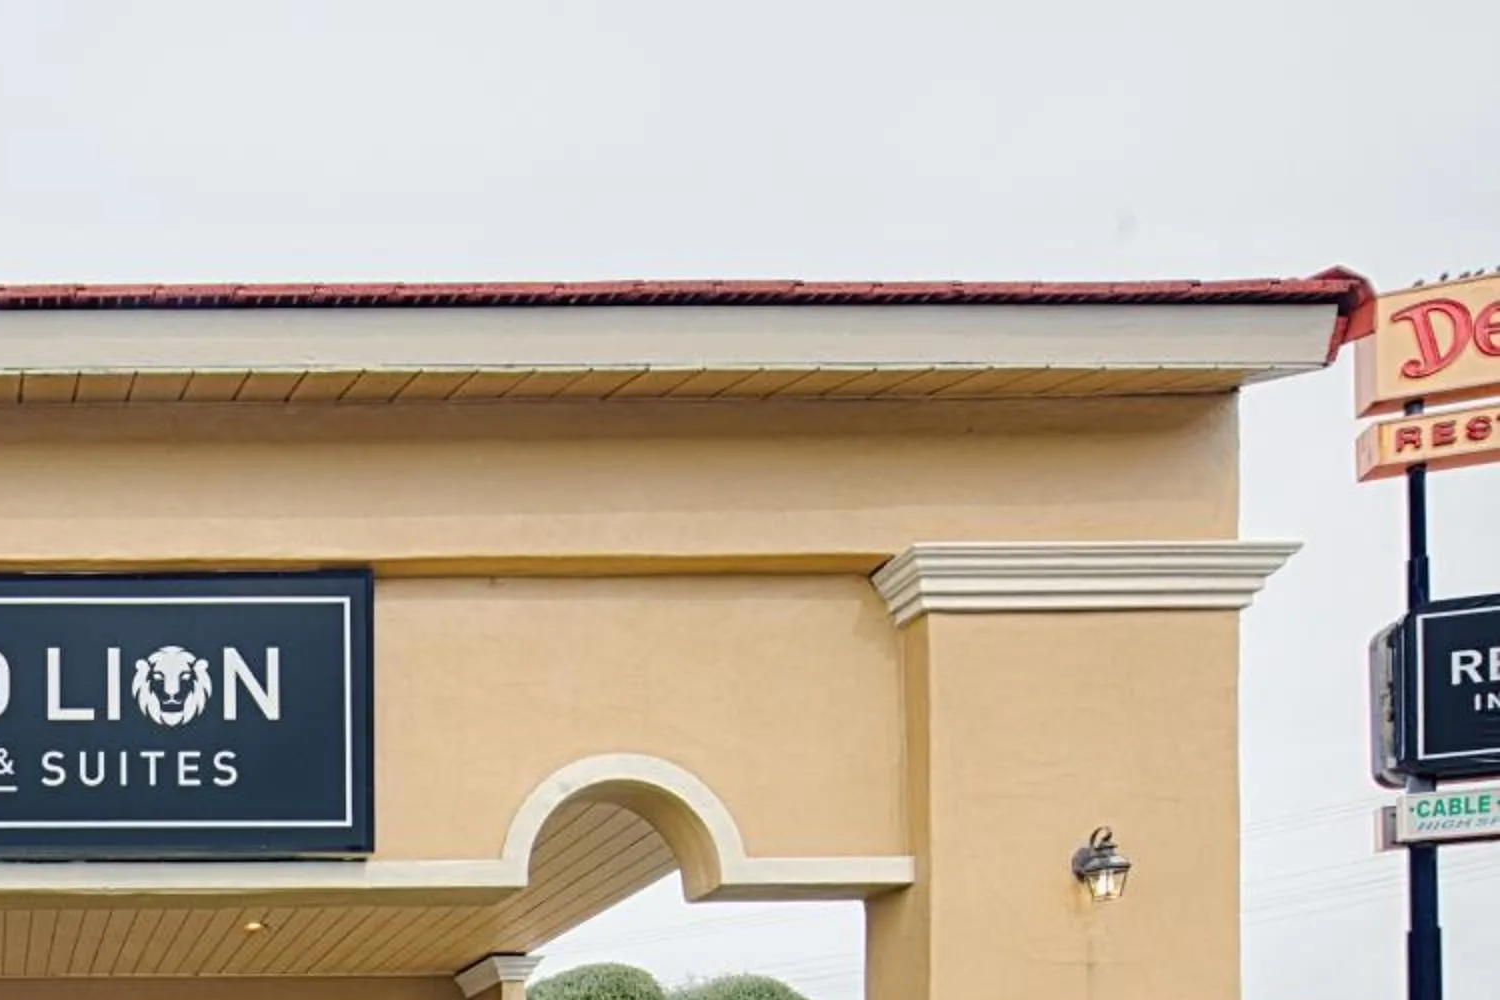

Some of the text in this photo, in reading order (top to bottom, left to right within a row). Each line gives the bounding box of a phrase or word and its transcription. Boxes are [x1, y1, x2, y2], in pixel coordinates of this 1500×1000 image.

[1396, 416, 1500, 453] RES
[41, 750, 239, 787] SUITES
[1416, 795, 1491, 818] CABLE
